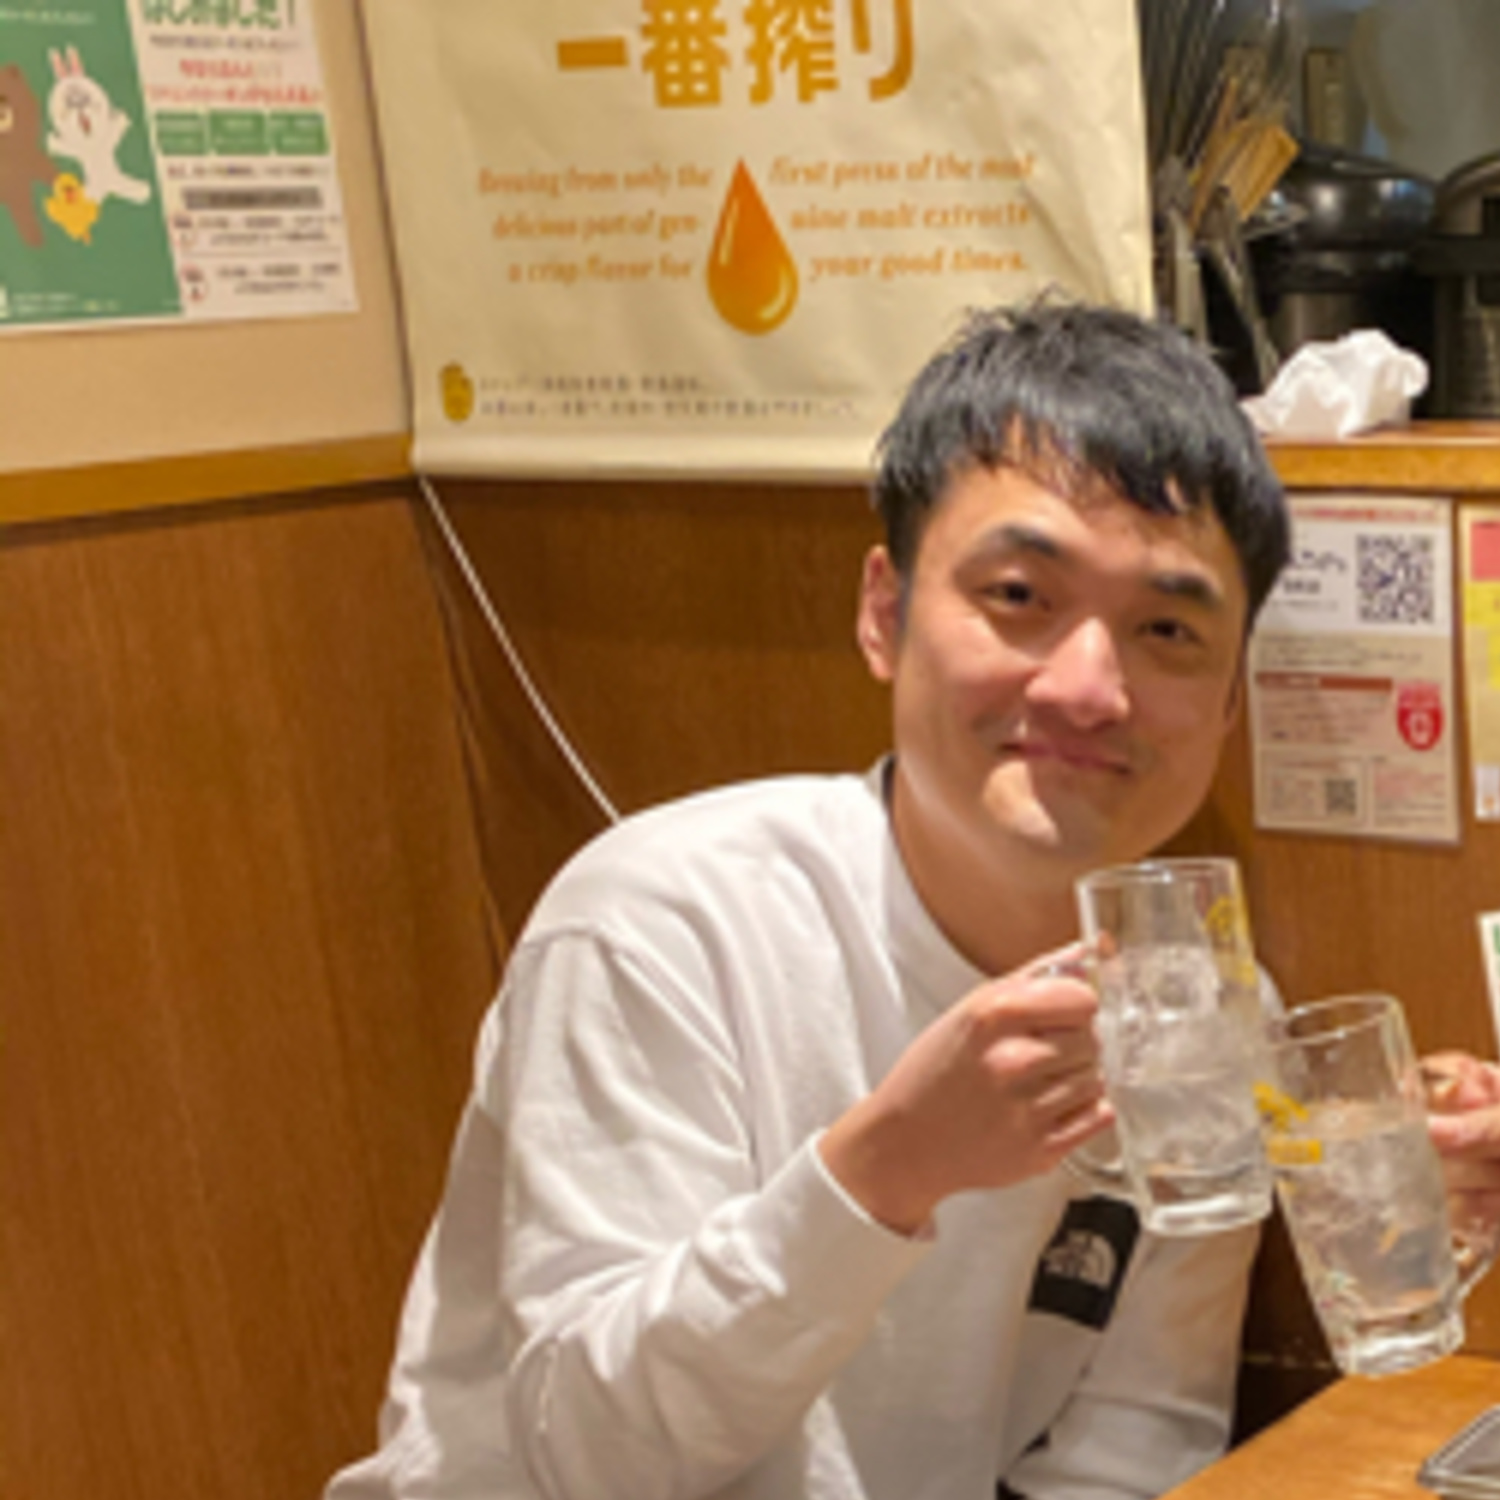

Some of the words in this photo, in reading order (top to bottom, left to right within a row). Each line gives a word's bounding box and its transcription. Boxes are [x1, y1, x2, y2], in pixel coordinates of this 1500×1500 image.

[556, 0, 914, 108] 一番搾り
[905, 153, 932, 181] of
[935, 153, 973, 180] the
